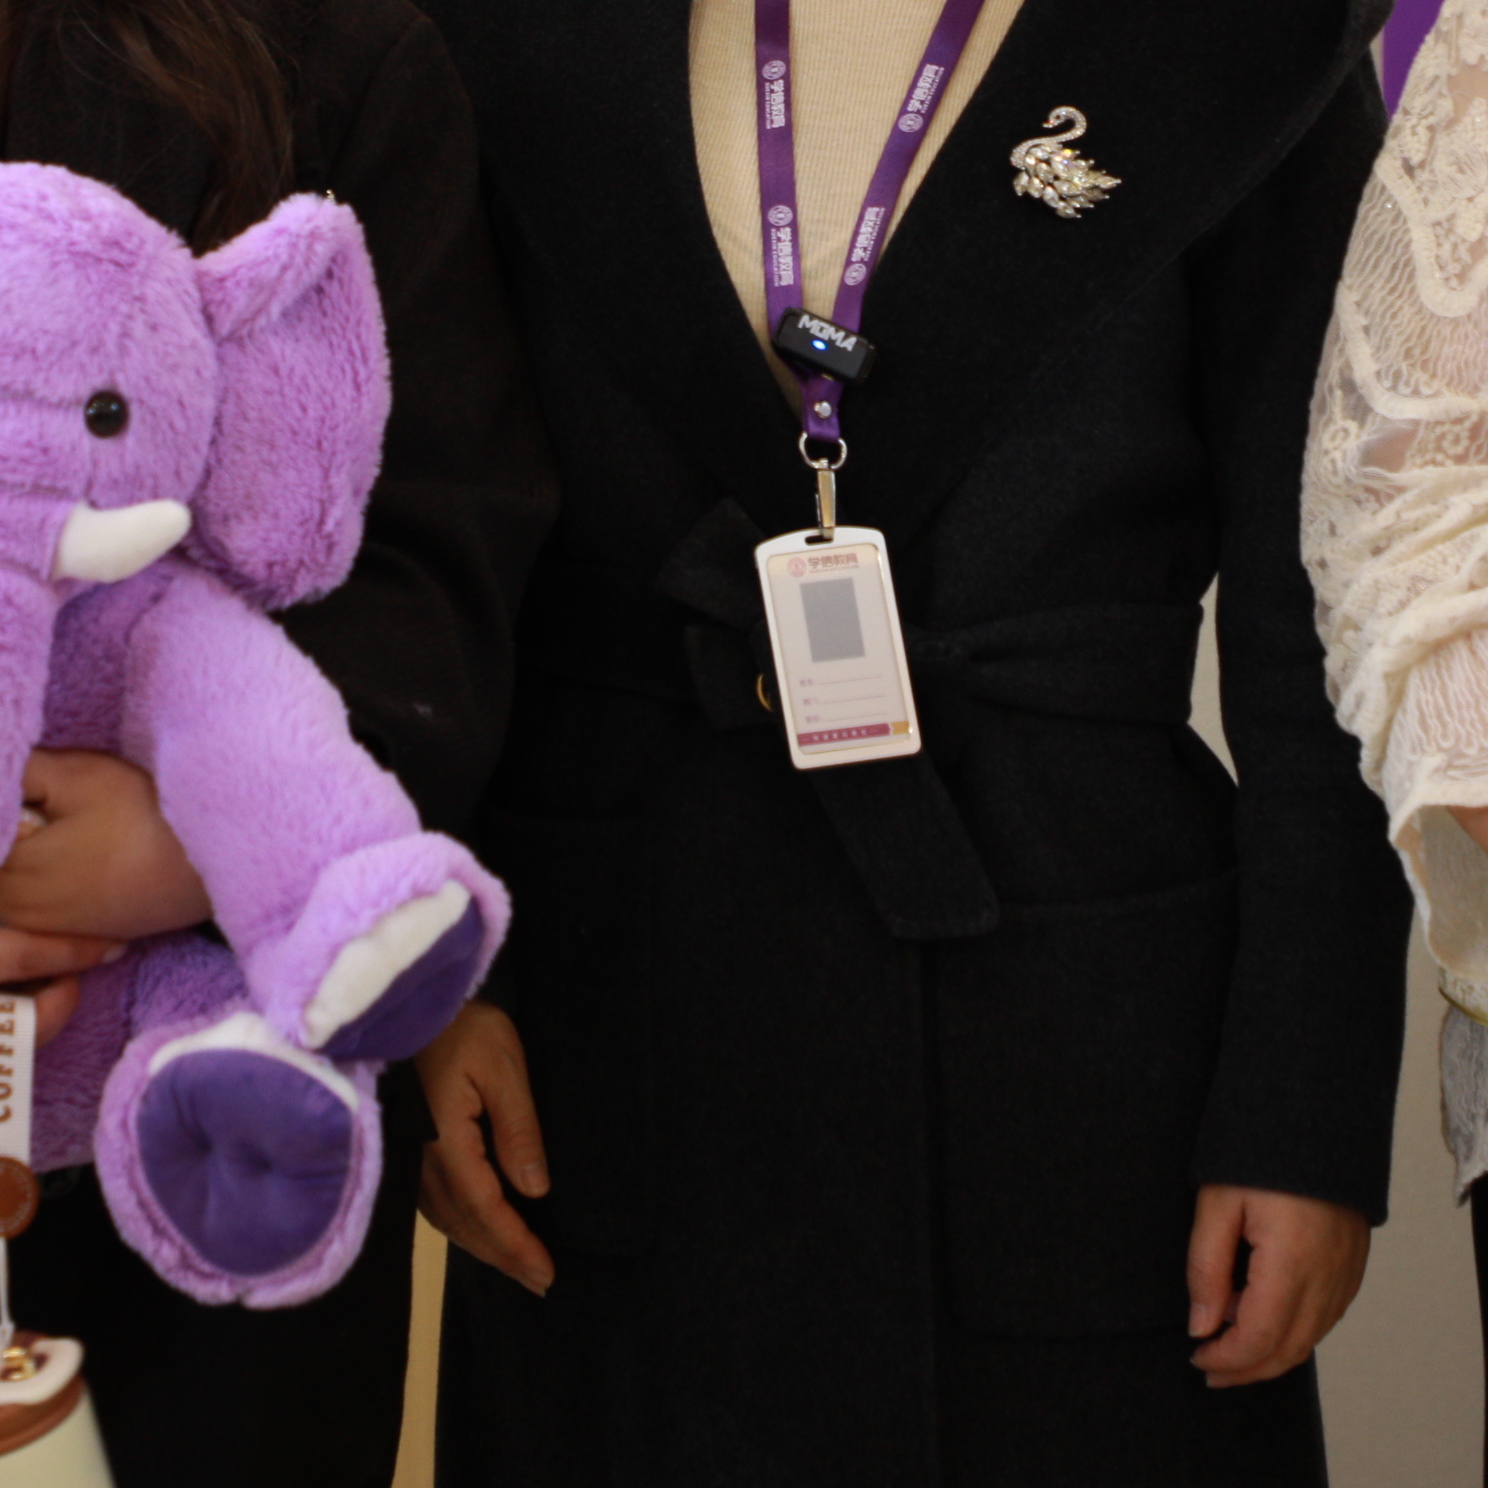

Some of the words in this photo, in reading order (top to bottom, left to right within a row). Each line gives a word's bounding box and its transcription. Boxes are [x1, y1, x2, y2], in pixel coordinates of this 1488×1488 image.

[771, 79, 785, 128] 学信教育
[907, 64, 939, 112] 学信教育
[777, 227, 794, 286] 学信教育
[851, 207, 879, 262] 学信教育
